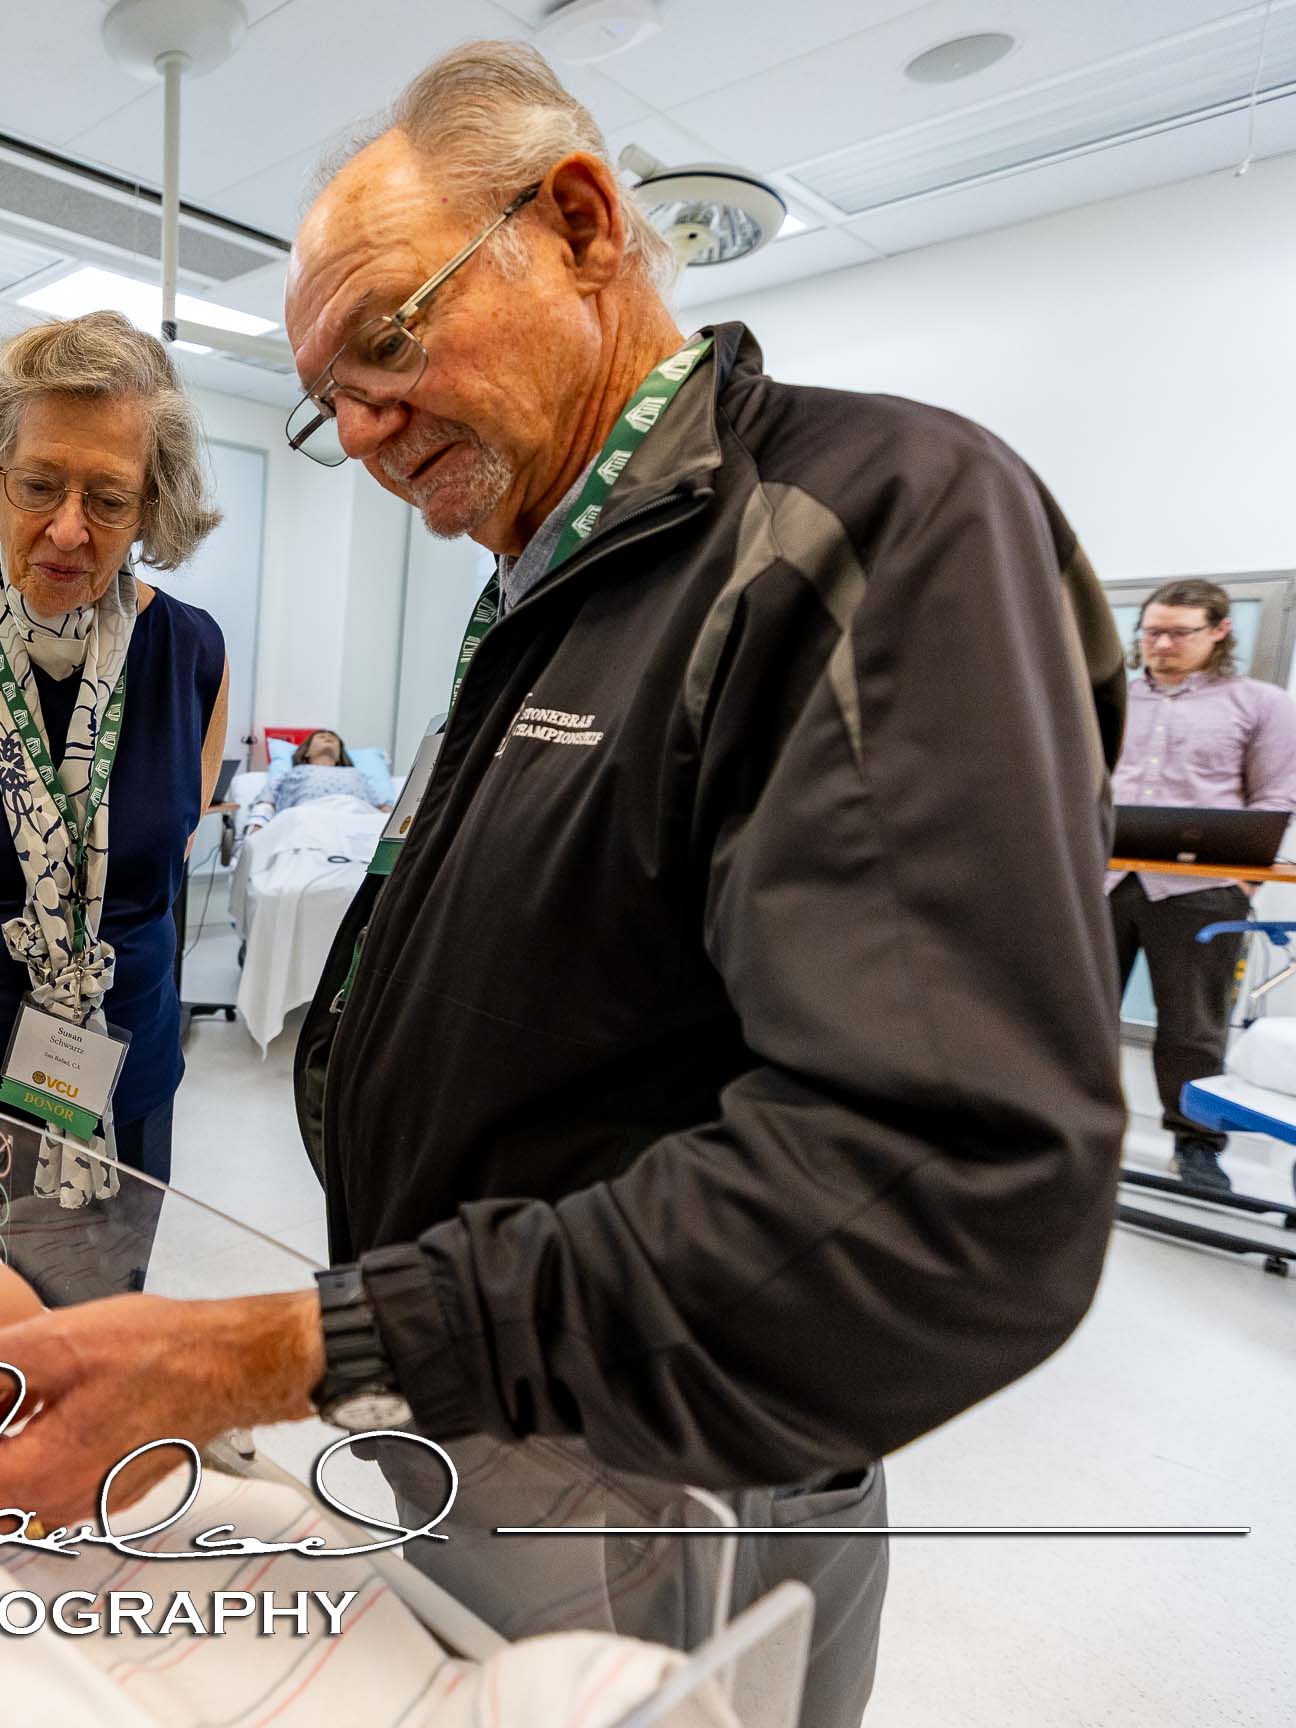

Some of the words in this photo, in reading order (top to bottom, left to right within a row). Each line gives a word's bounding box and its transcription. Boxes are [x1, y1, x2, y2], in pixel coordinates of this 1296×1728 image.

[58, 1027, 83, 1042] Susan
[49, 1036, 86, 1054] Schwartz
[46, 1076, 80, 1098] VCU
[24, 1092, 74, 1122] DONOR
